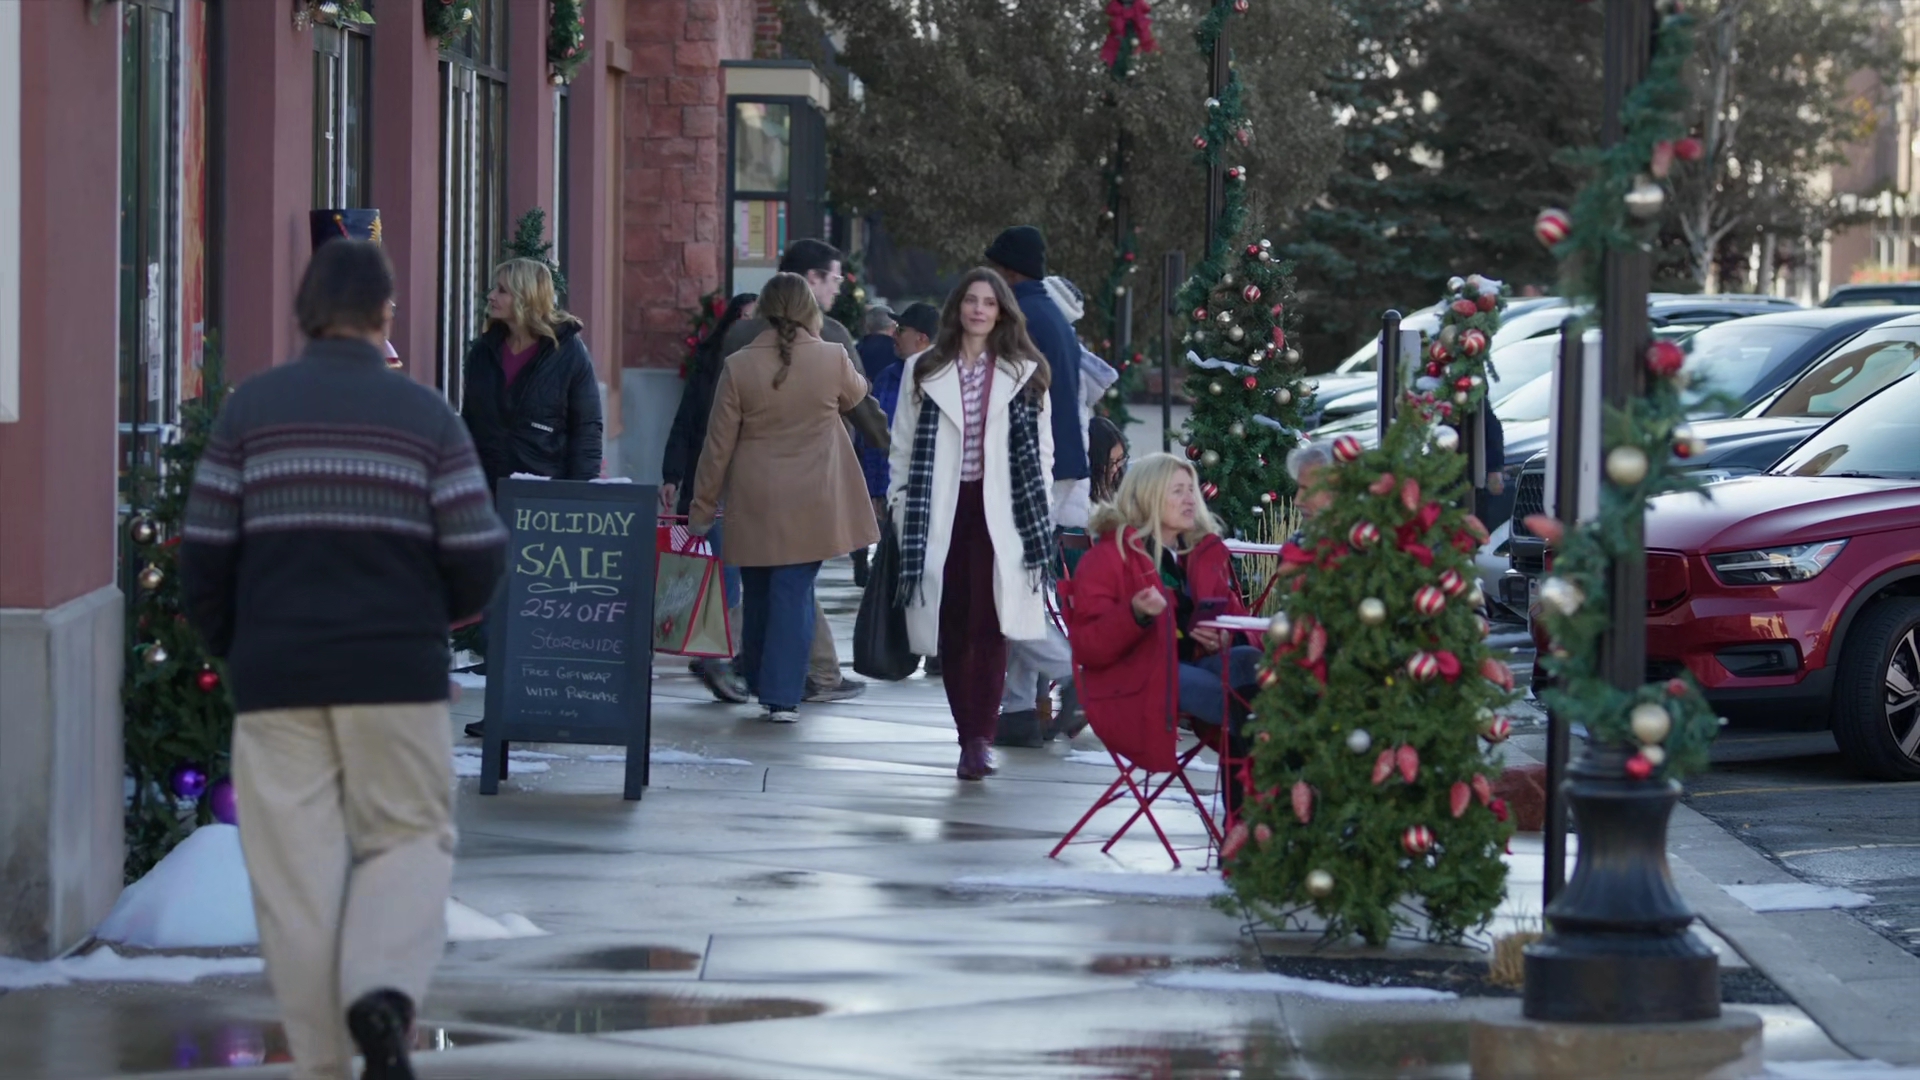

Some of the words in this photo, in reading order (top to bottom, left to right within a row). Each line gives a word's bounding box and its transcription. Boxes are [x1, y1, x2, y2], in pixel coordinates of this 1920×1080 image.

[516, 508, 635, 536] HOLIDAY
[516, 542, 623, 581] SALE
[519, 598, 572, 619] 25%
[577, 601, 627, 623] OFF
[521, 663, 550, 677] FREE
[525, 686, 558, 697] WITH
[564, 685, 619, 704] PURCHASE
